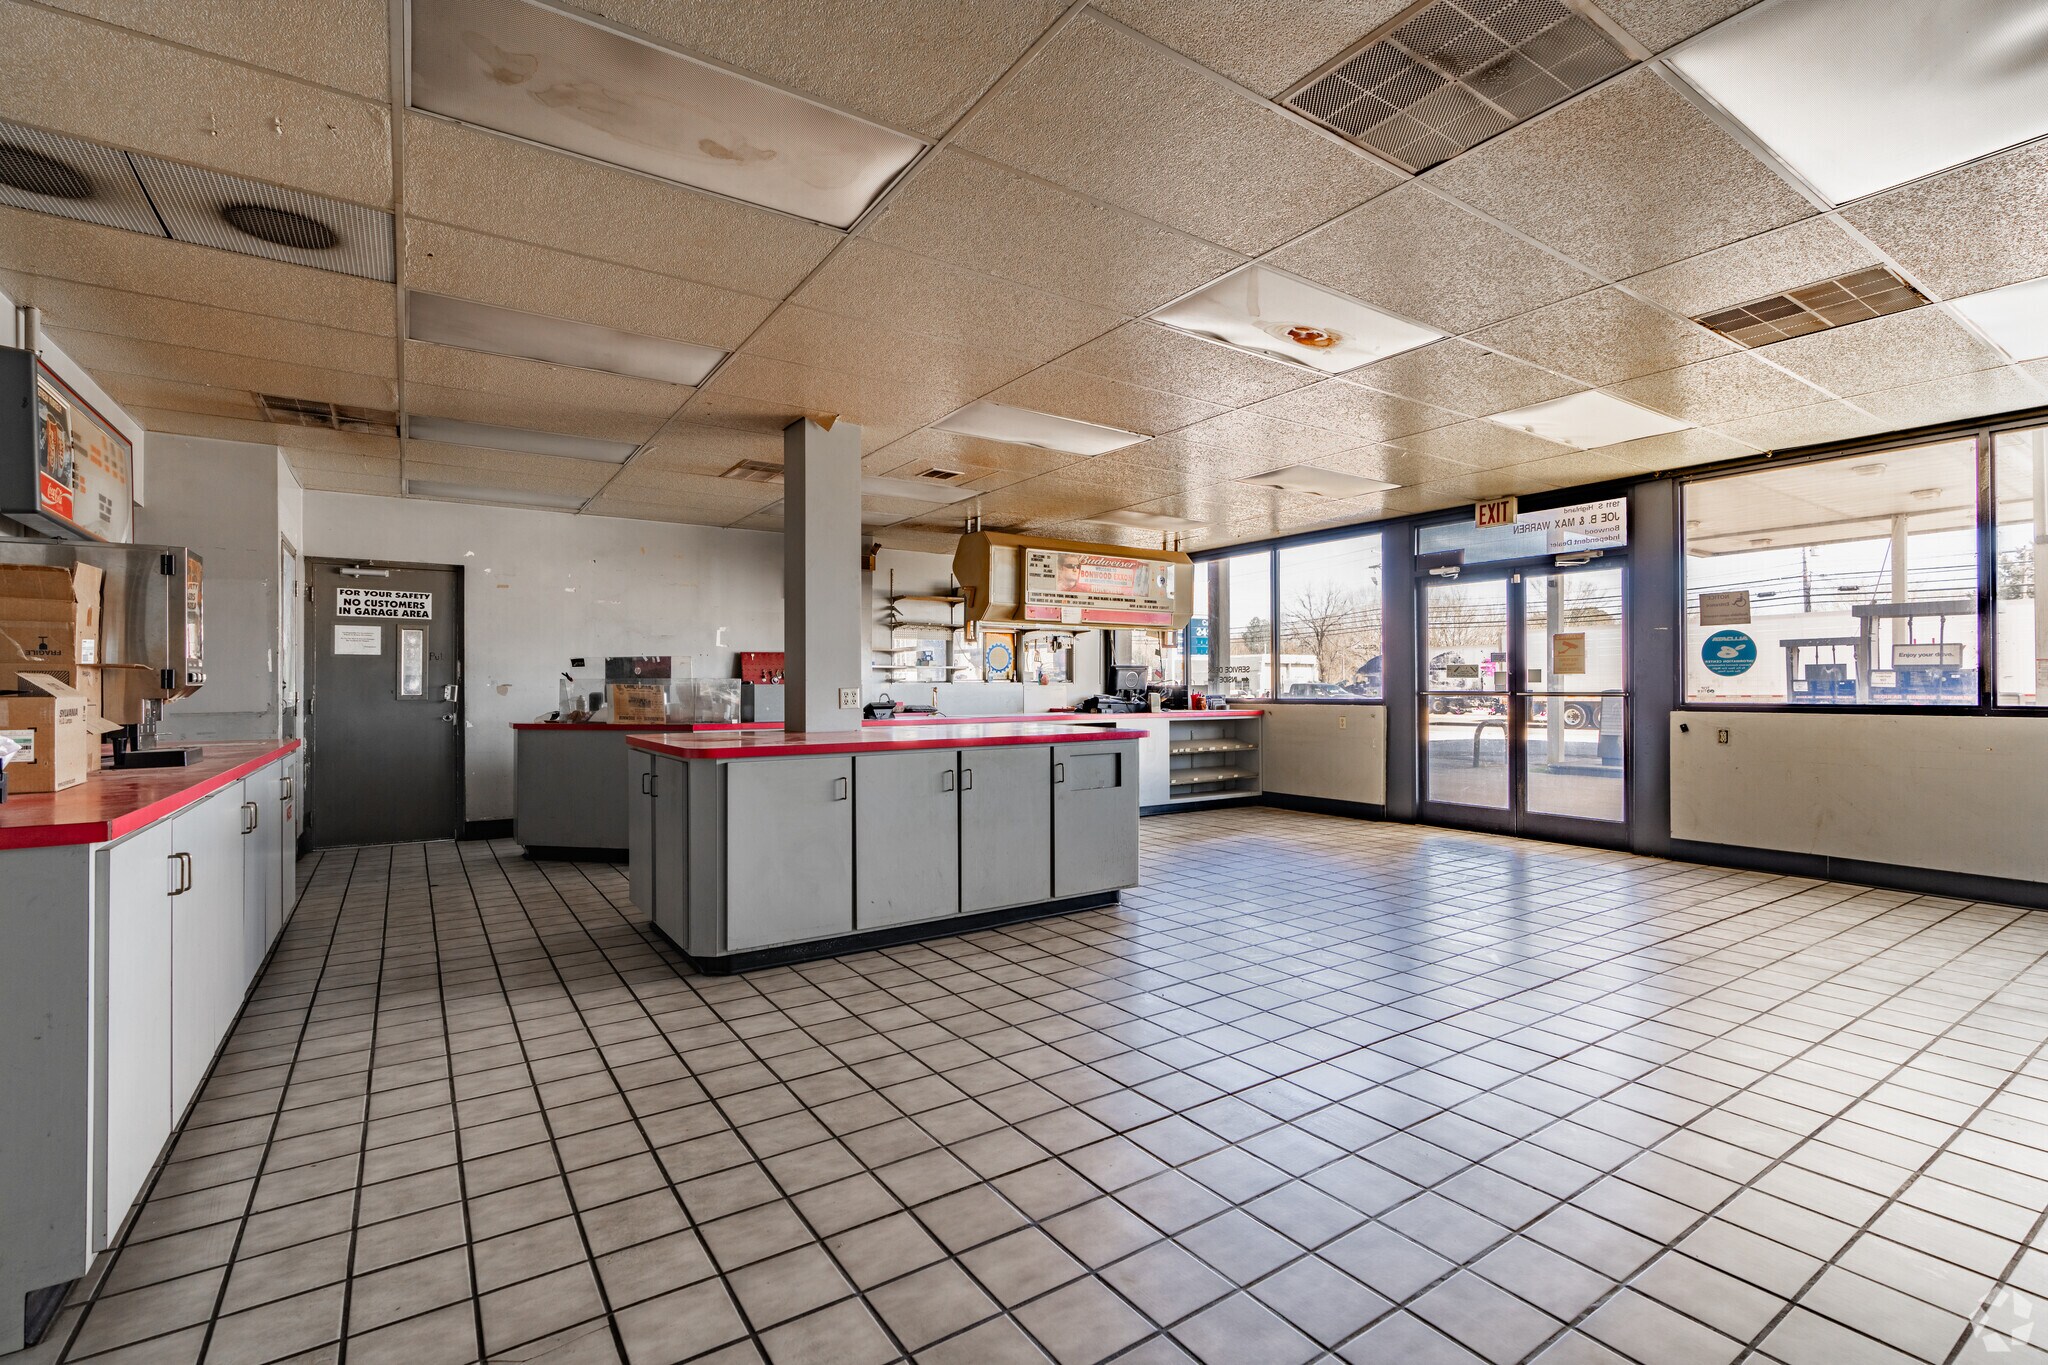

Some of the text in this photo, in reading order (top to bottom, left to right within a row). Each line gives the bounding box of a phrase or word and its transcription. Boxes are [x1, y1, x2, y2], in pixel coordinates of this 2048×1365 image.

[1480, 500, 1510, 526] EXIT
[1078, 554, 1137, 568] Budweiser
[1080, 570, 1134, 582] BONWOOD EXXON
[364, 599, 425, 610] CUSTOMERS
[354, 608, 398, 617] GARAGE
[402, 610, 429, 618] AREA
[59, 708, 78, 718] SYLVANIA
